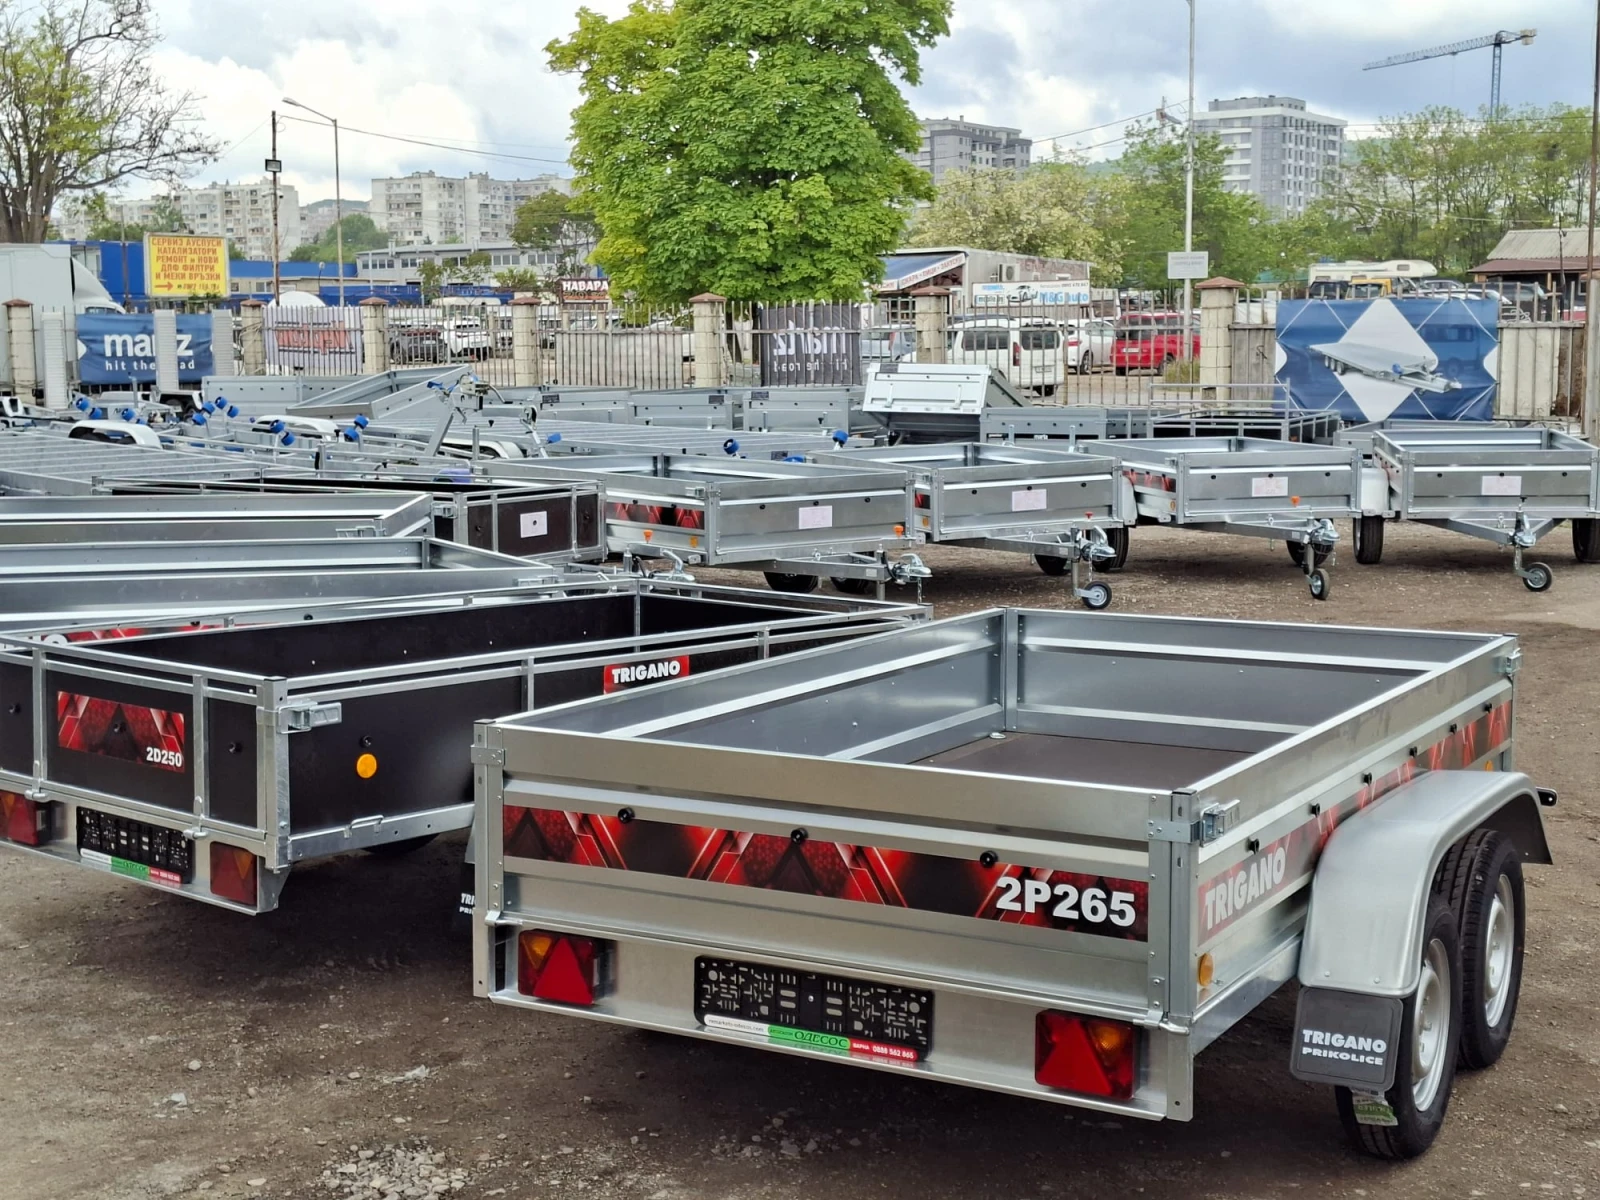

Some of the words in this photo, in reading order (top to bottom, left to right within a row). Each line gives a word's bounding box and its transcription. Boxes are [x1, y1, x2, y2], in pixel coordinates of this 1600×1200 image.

[152, 238, 183, 246] СЕРВИЗ
[186, 239, 222, 247] АУСПУСИ
[157, 247, 217, 255] КАТАЛИЗАТОРИ
[156, 255, 187, 263] РЕМОНТ
[161, 264, 179, 273] ДПФ
[182, 264, 215, 272] ФИЛТРИ
[164, 272, 186, 280] МЕКИ
[189, 273, 221, 281] ВРЪЗКИ
[104, 333, 194, 357] maz
[105, 360, 126, 371] hit
[133, 360, 157, 370] the
[612, 660, 681, 684] TRIGANO
[146, 746, 182, 768] 2D250
[1205, 847, 1286, 931] TRIGANO
[996, 876, 1136, 927] 2P265
[794, 1031, 848, 1048] ОДЕСОС
[1302, 1029, 1387, 1053] TRIGANO
[1301, 1047, 1384, 1066] PRIKOLICE
